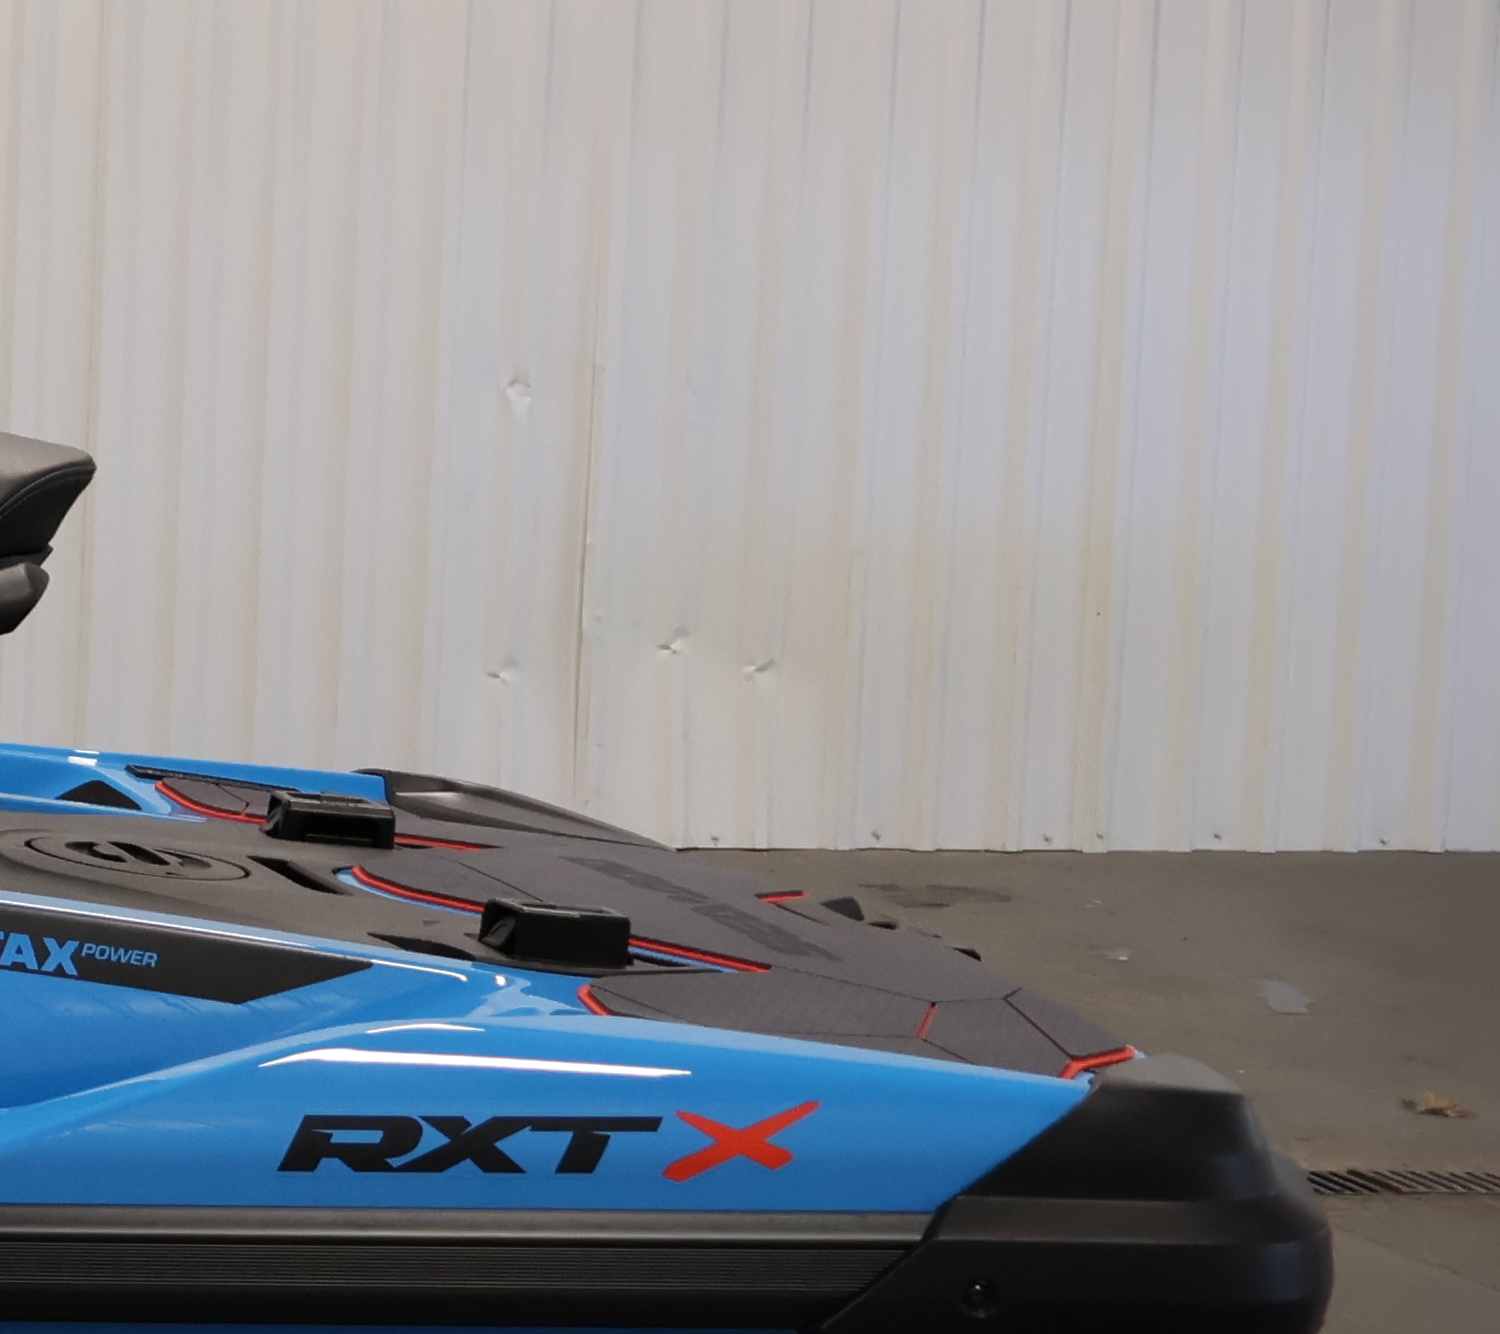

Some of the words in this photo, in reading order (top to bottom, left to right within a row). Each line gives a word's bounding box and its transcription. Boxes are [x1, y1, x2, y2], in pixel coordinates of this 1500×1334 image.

[81, 943, 158, 968] POWER
[276, 1114, 663, 1175] RXT
[661, 1100, 821, 1182] X
